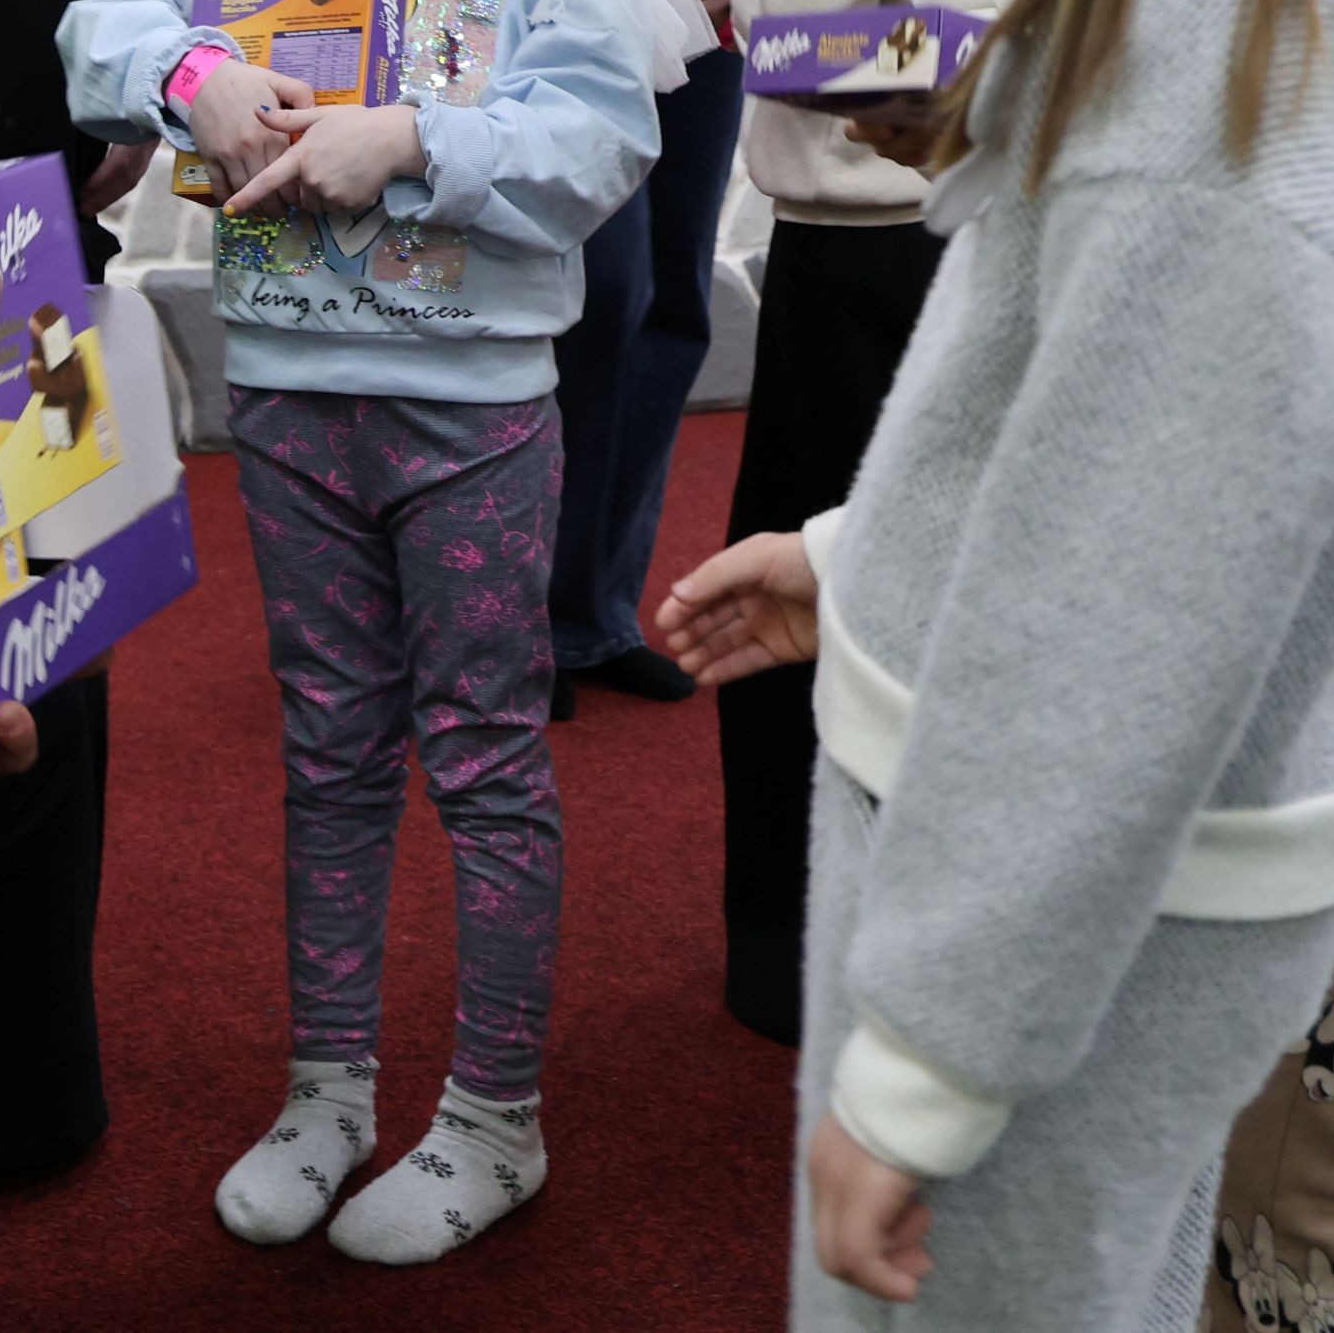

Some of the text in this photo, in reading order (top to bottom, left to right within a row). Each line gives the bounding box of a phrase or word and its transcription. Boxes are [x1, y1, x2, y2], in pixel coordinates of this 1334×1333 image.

[751, 26, 811, 75] Milka
[251, 277, 476, 322] being a Princess
[0, 564, 106, 702] Milka
